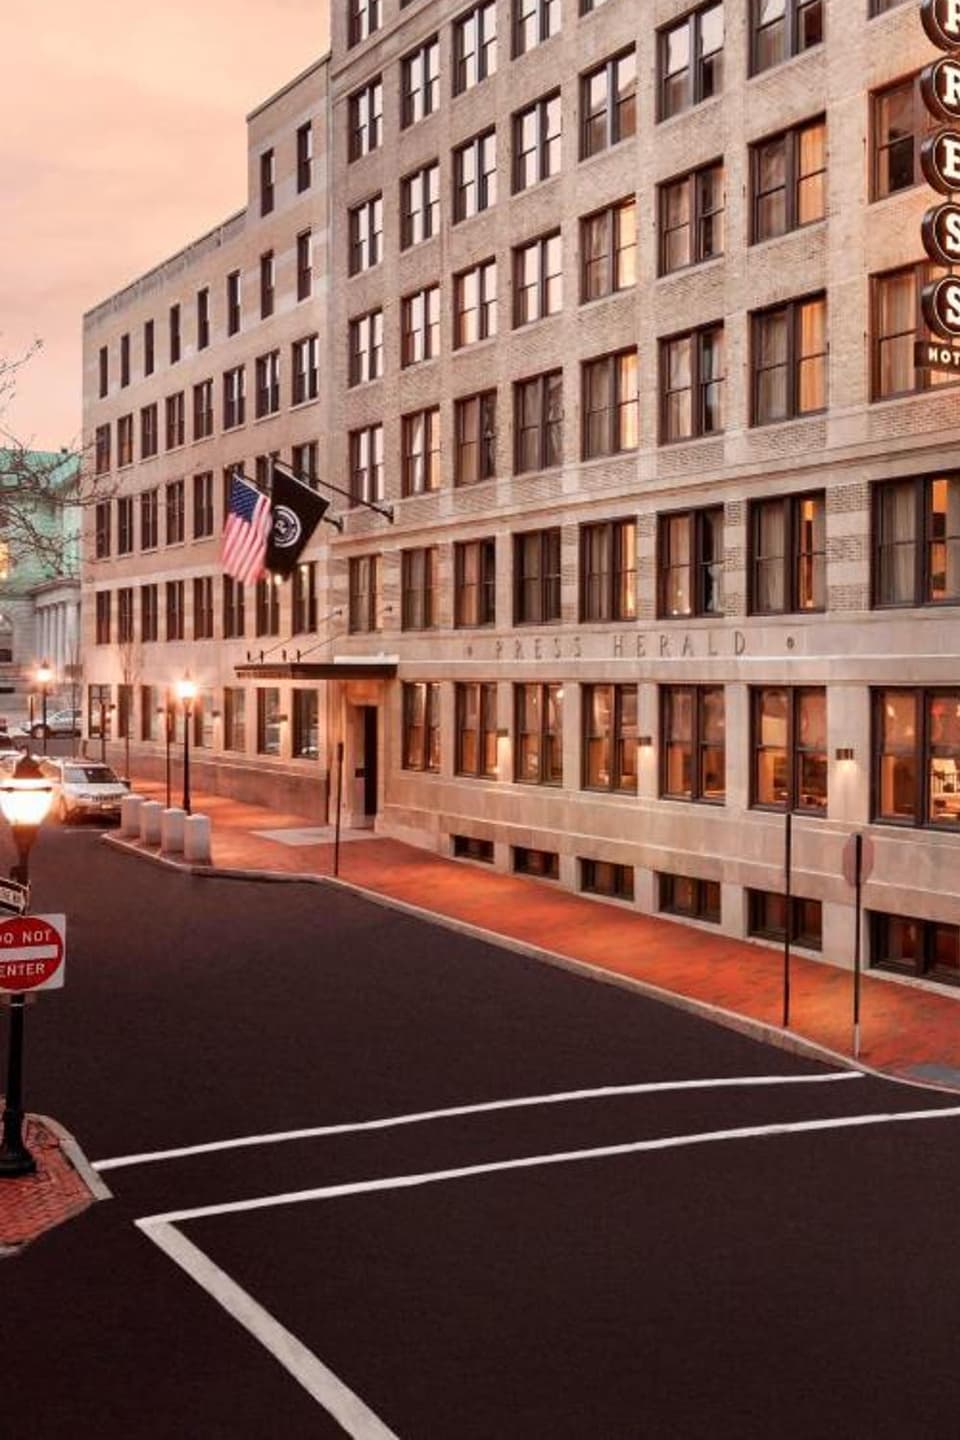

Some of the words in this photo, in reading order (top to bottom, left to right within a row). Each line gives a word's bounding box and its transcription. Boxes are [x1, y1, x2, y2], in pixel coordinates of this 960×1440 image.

[496, 636, 582, 659] PRESS
[613, 631, 746, 657] HERALD
[0, 932, 14, 945] O
[22, 930, 52, 944] NOT
